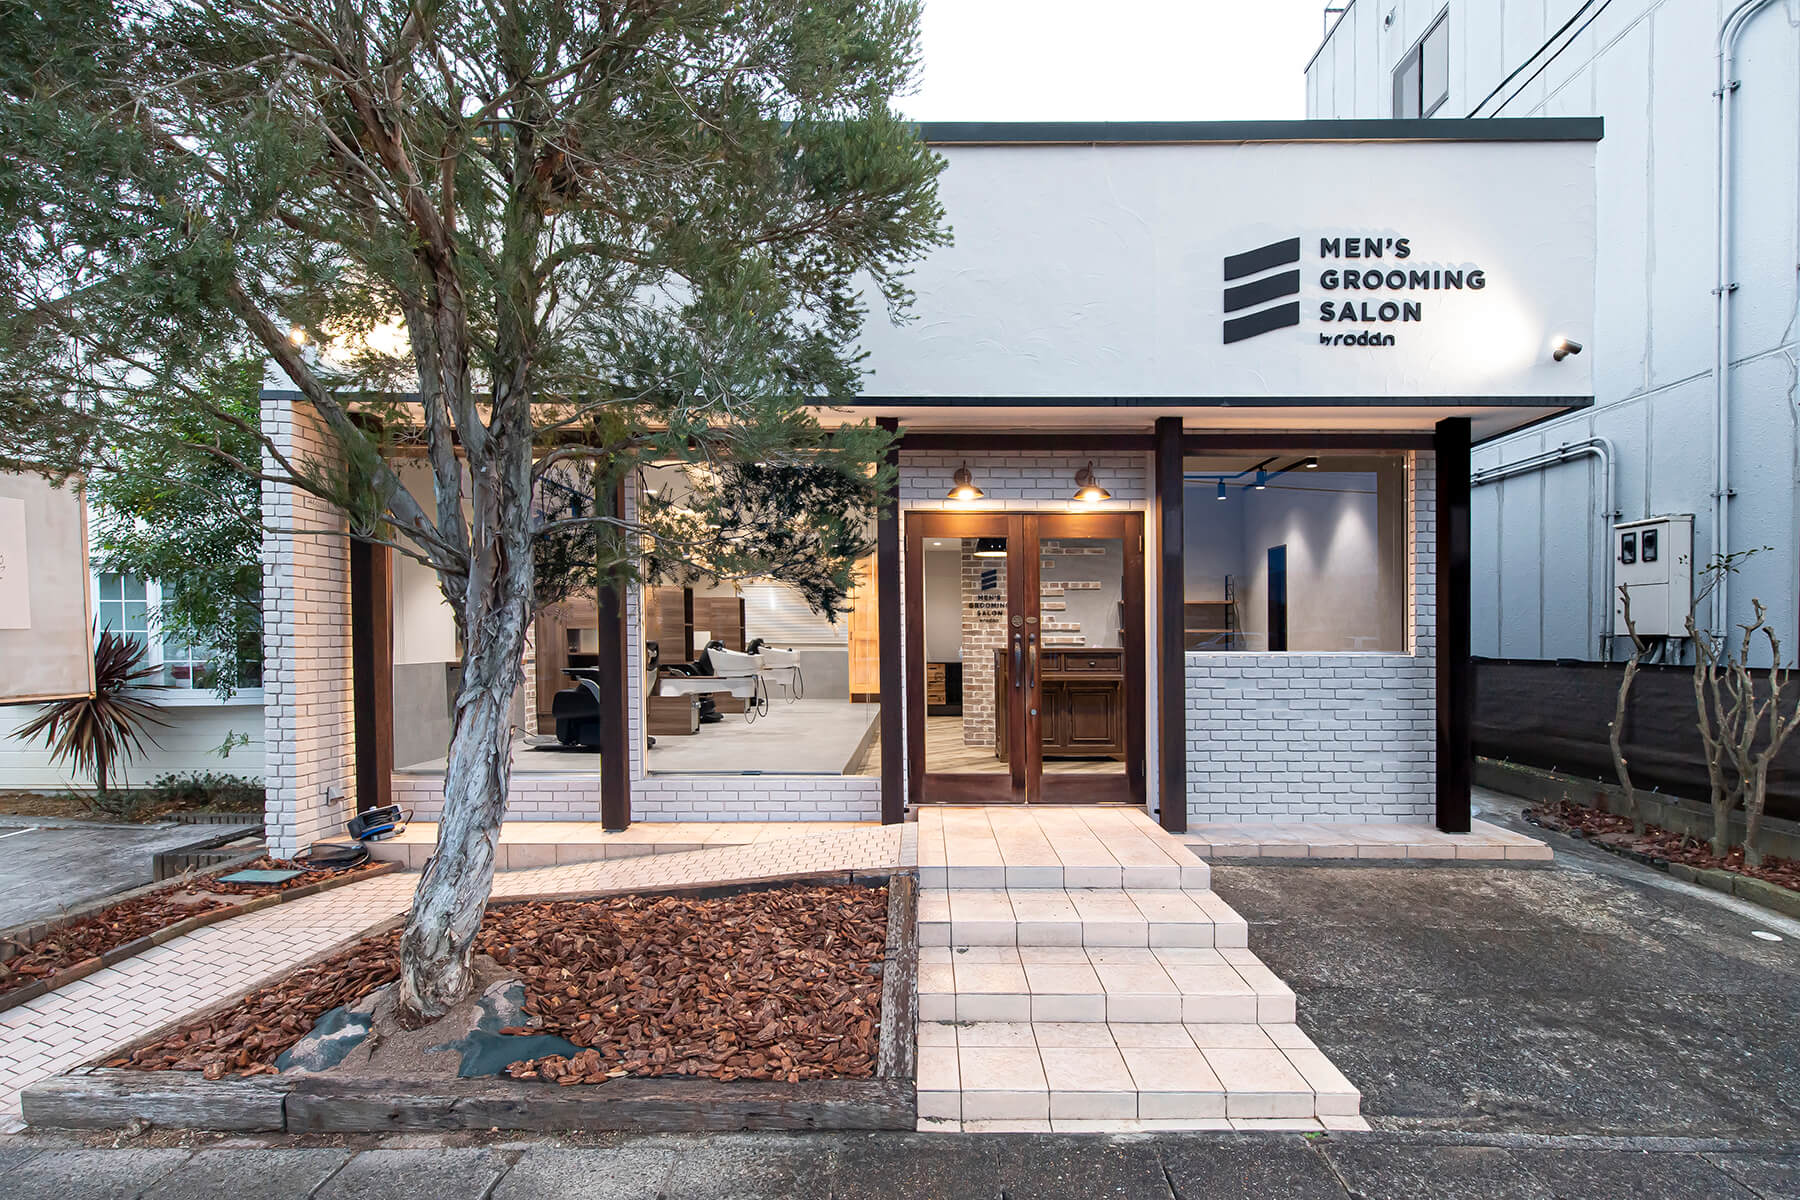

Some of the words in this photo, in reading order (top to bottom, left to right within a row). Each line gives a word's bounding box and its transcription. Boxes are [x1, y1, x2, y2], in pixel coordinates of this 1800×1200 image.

[1320, 237, 1411, 258] MEN'S
[1320, 270, 1486, 290] GROOMING
[1319, 301, 1422, 322] SALON
[1319, 332, 1332, 346] by
